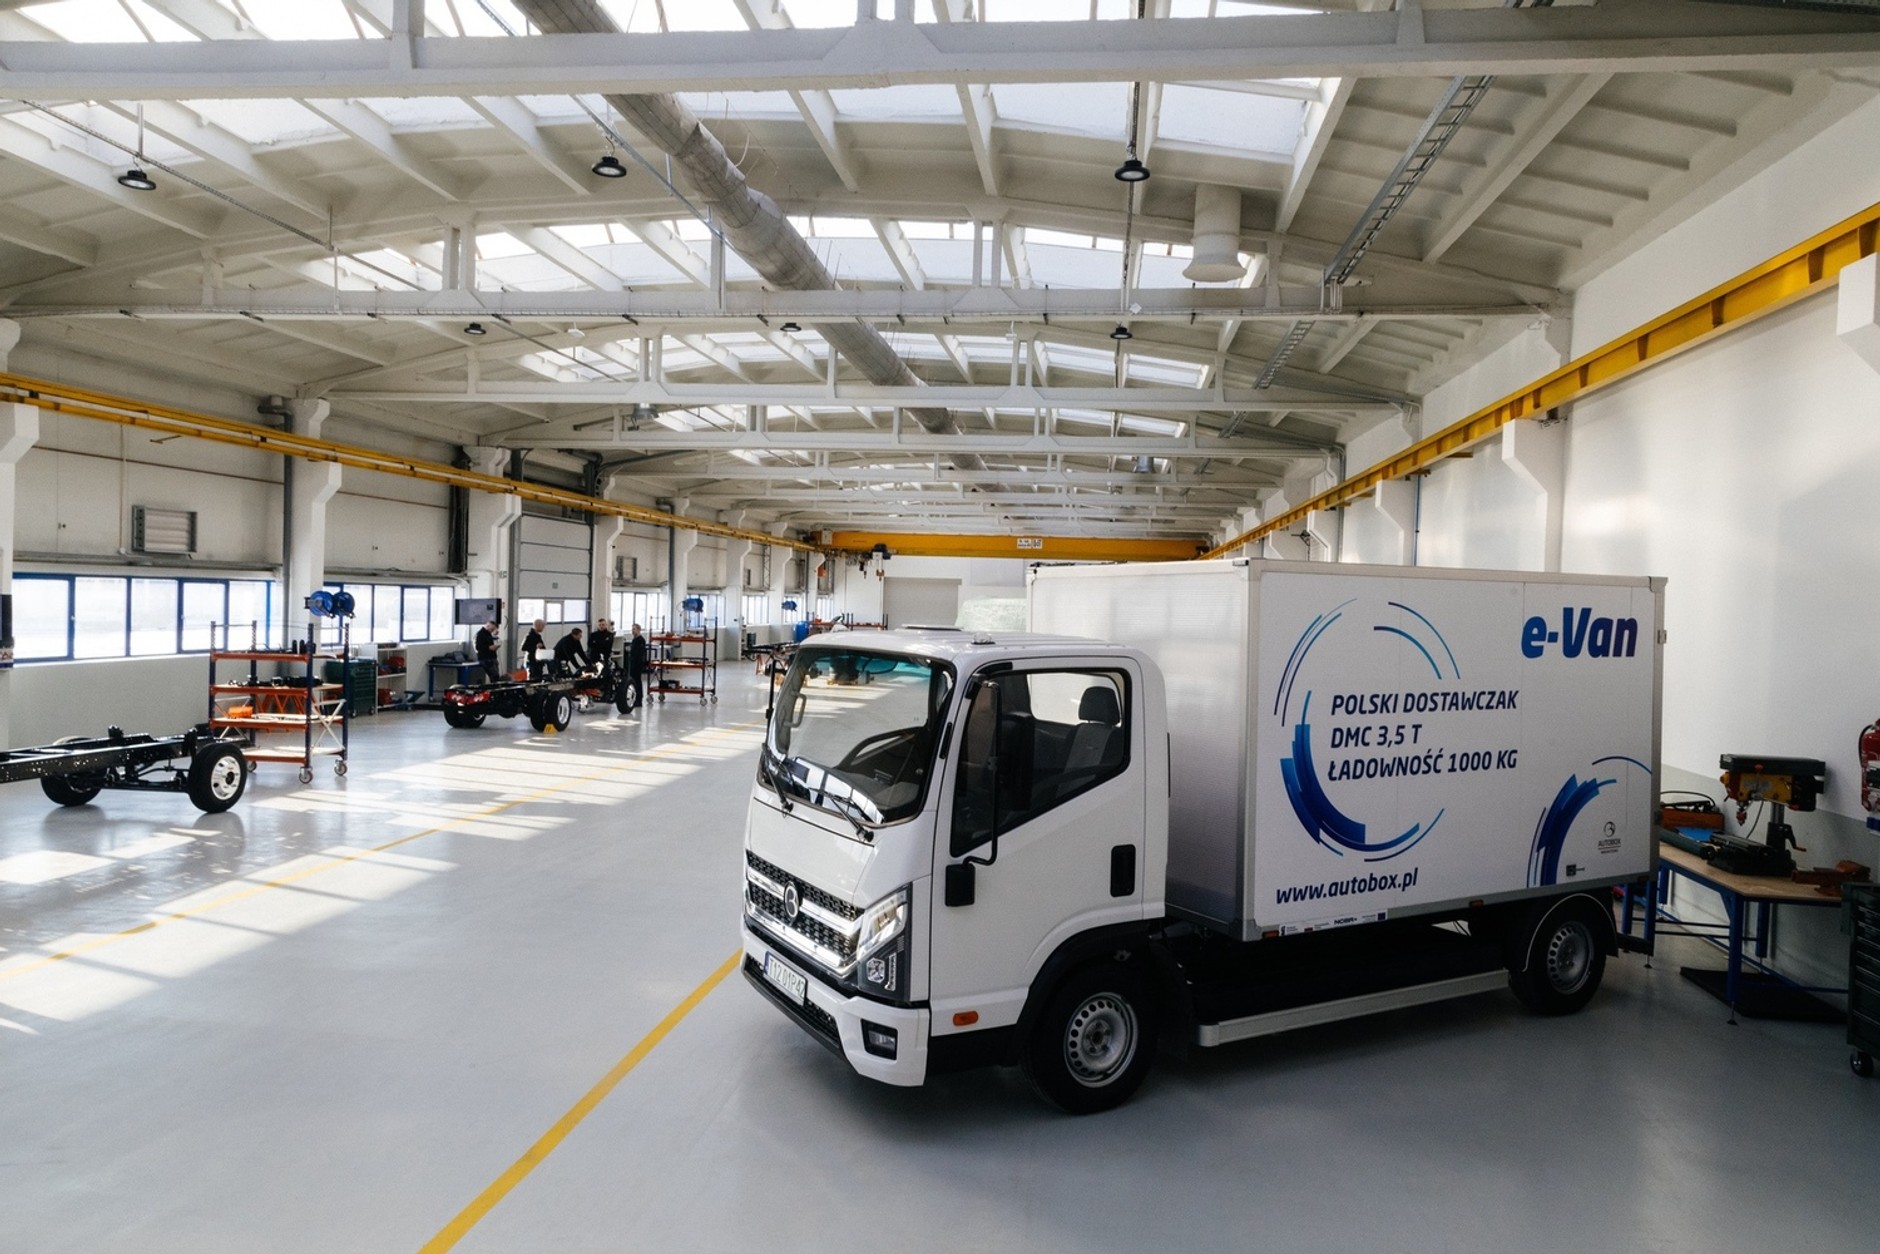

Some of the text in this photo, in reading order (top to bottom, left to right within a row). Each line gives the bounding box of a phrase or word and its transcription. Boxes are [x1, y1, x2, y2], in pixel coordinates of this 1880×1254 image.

[1521, 607, 1638, 659] e-Van
[1331, 690, 1519, 716] POLSKI DOSTAWCZAK
[1331, 724, 1422, 748] DMC 3,5 T
[1328, 749, 1518, 781] ŁADOWNOŚĆ 1000 KG
[1276, 867, 1418, 904] www.autobox.pl
